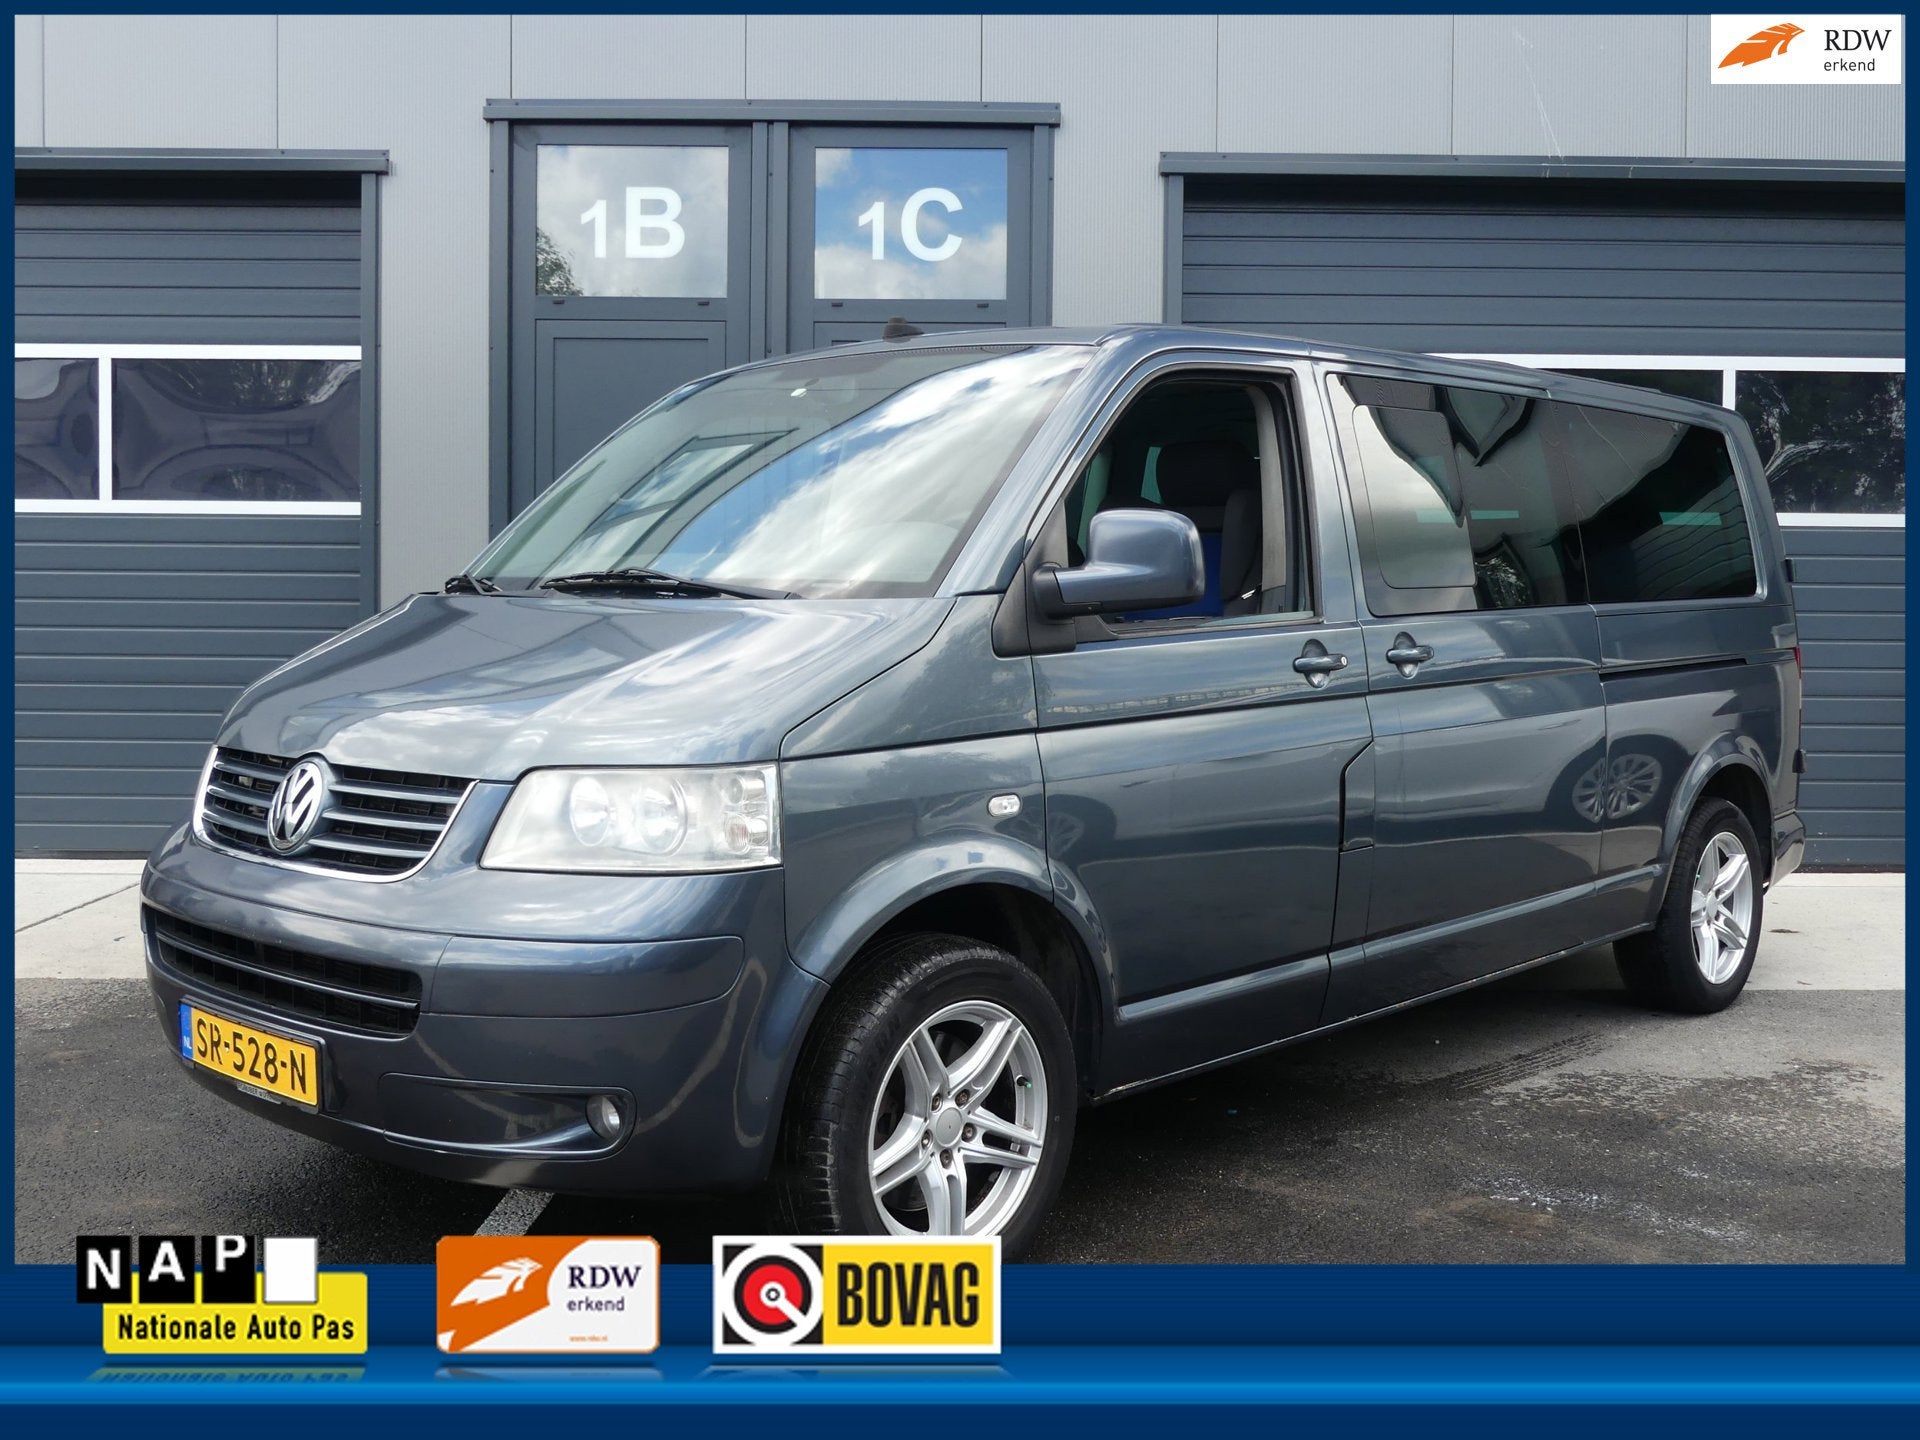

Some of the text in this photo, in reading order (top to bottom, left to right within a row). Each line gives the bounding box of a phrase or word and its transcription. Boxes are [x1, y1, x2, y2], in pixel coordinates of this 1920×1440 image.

[580, 186, 686, 260] 1B
[858, 187, 964, 262] 1C
[196, 1017, 307, 1095] SR-528-N
